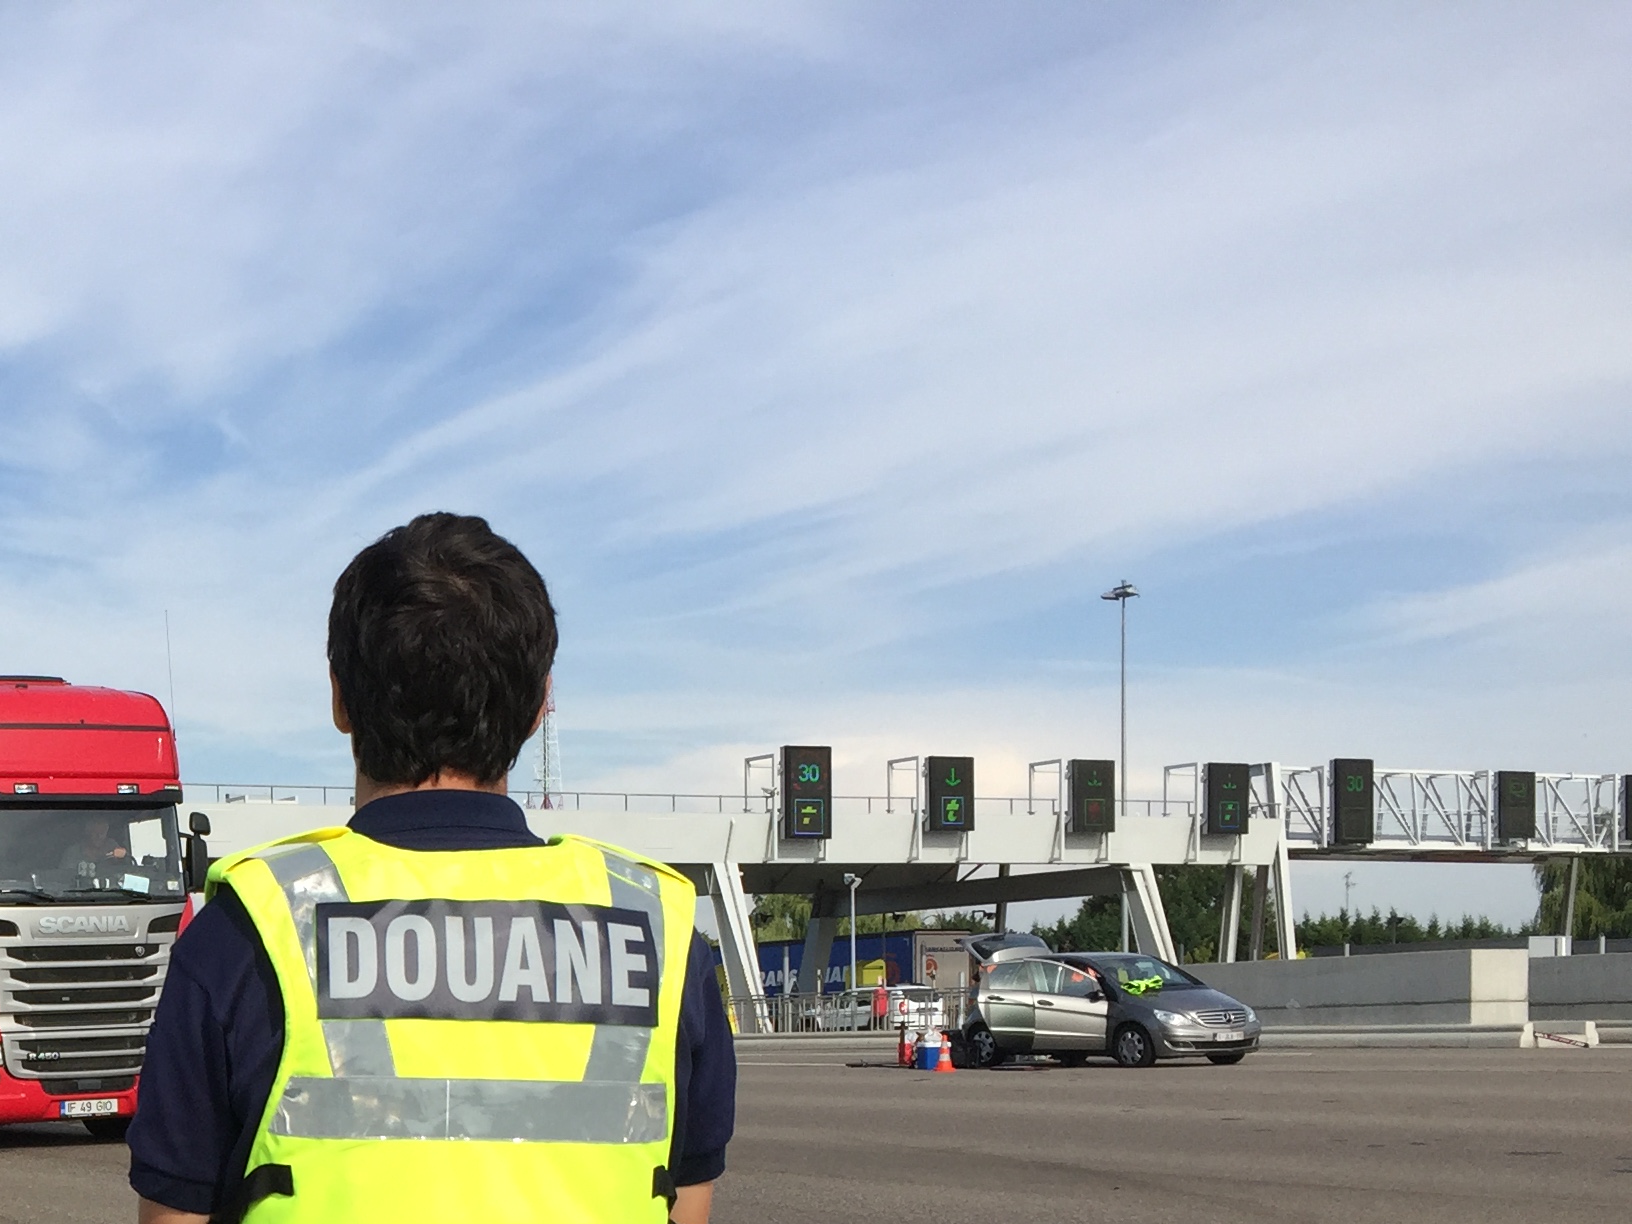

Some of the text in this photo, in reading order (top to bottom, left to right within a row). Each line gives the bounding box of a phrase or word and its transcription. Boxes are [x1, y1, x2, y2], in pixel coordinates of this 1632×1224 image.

[798, 763, 820, 782] 30
[1346, 775, 1364, 792] 30
[38, 915, 130, 934] SCANIA
[327, 914, 650, 1008] DOUANE
[80, 1101, 92, 1112] 49
